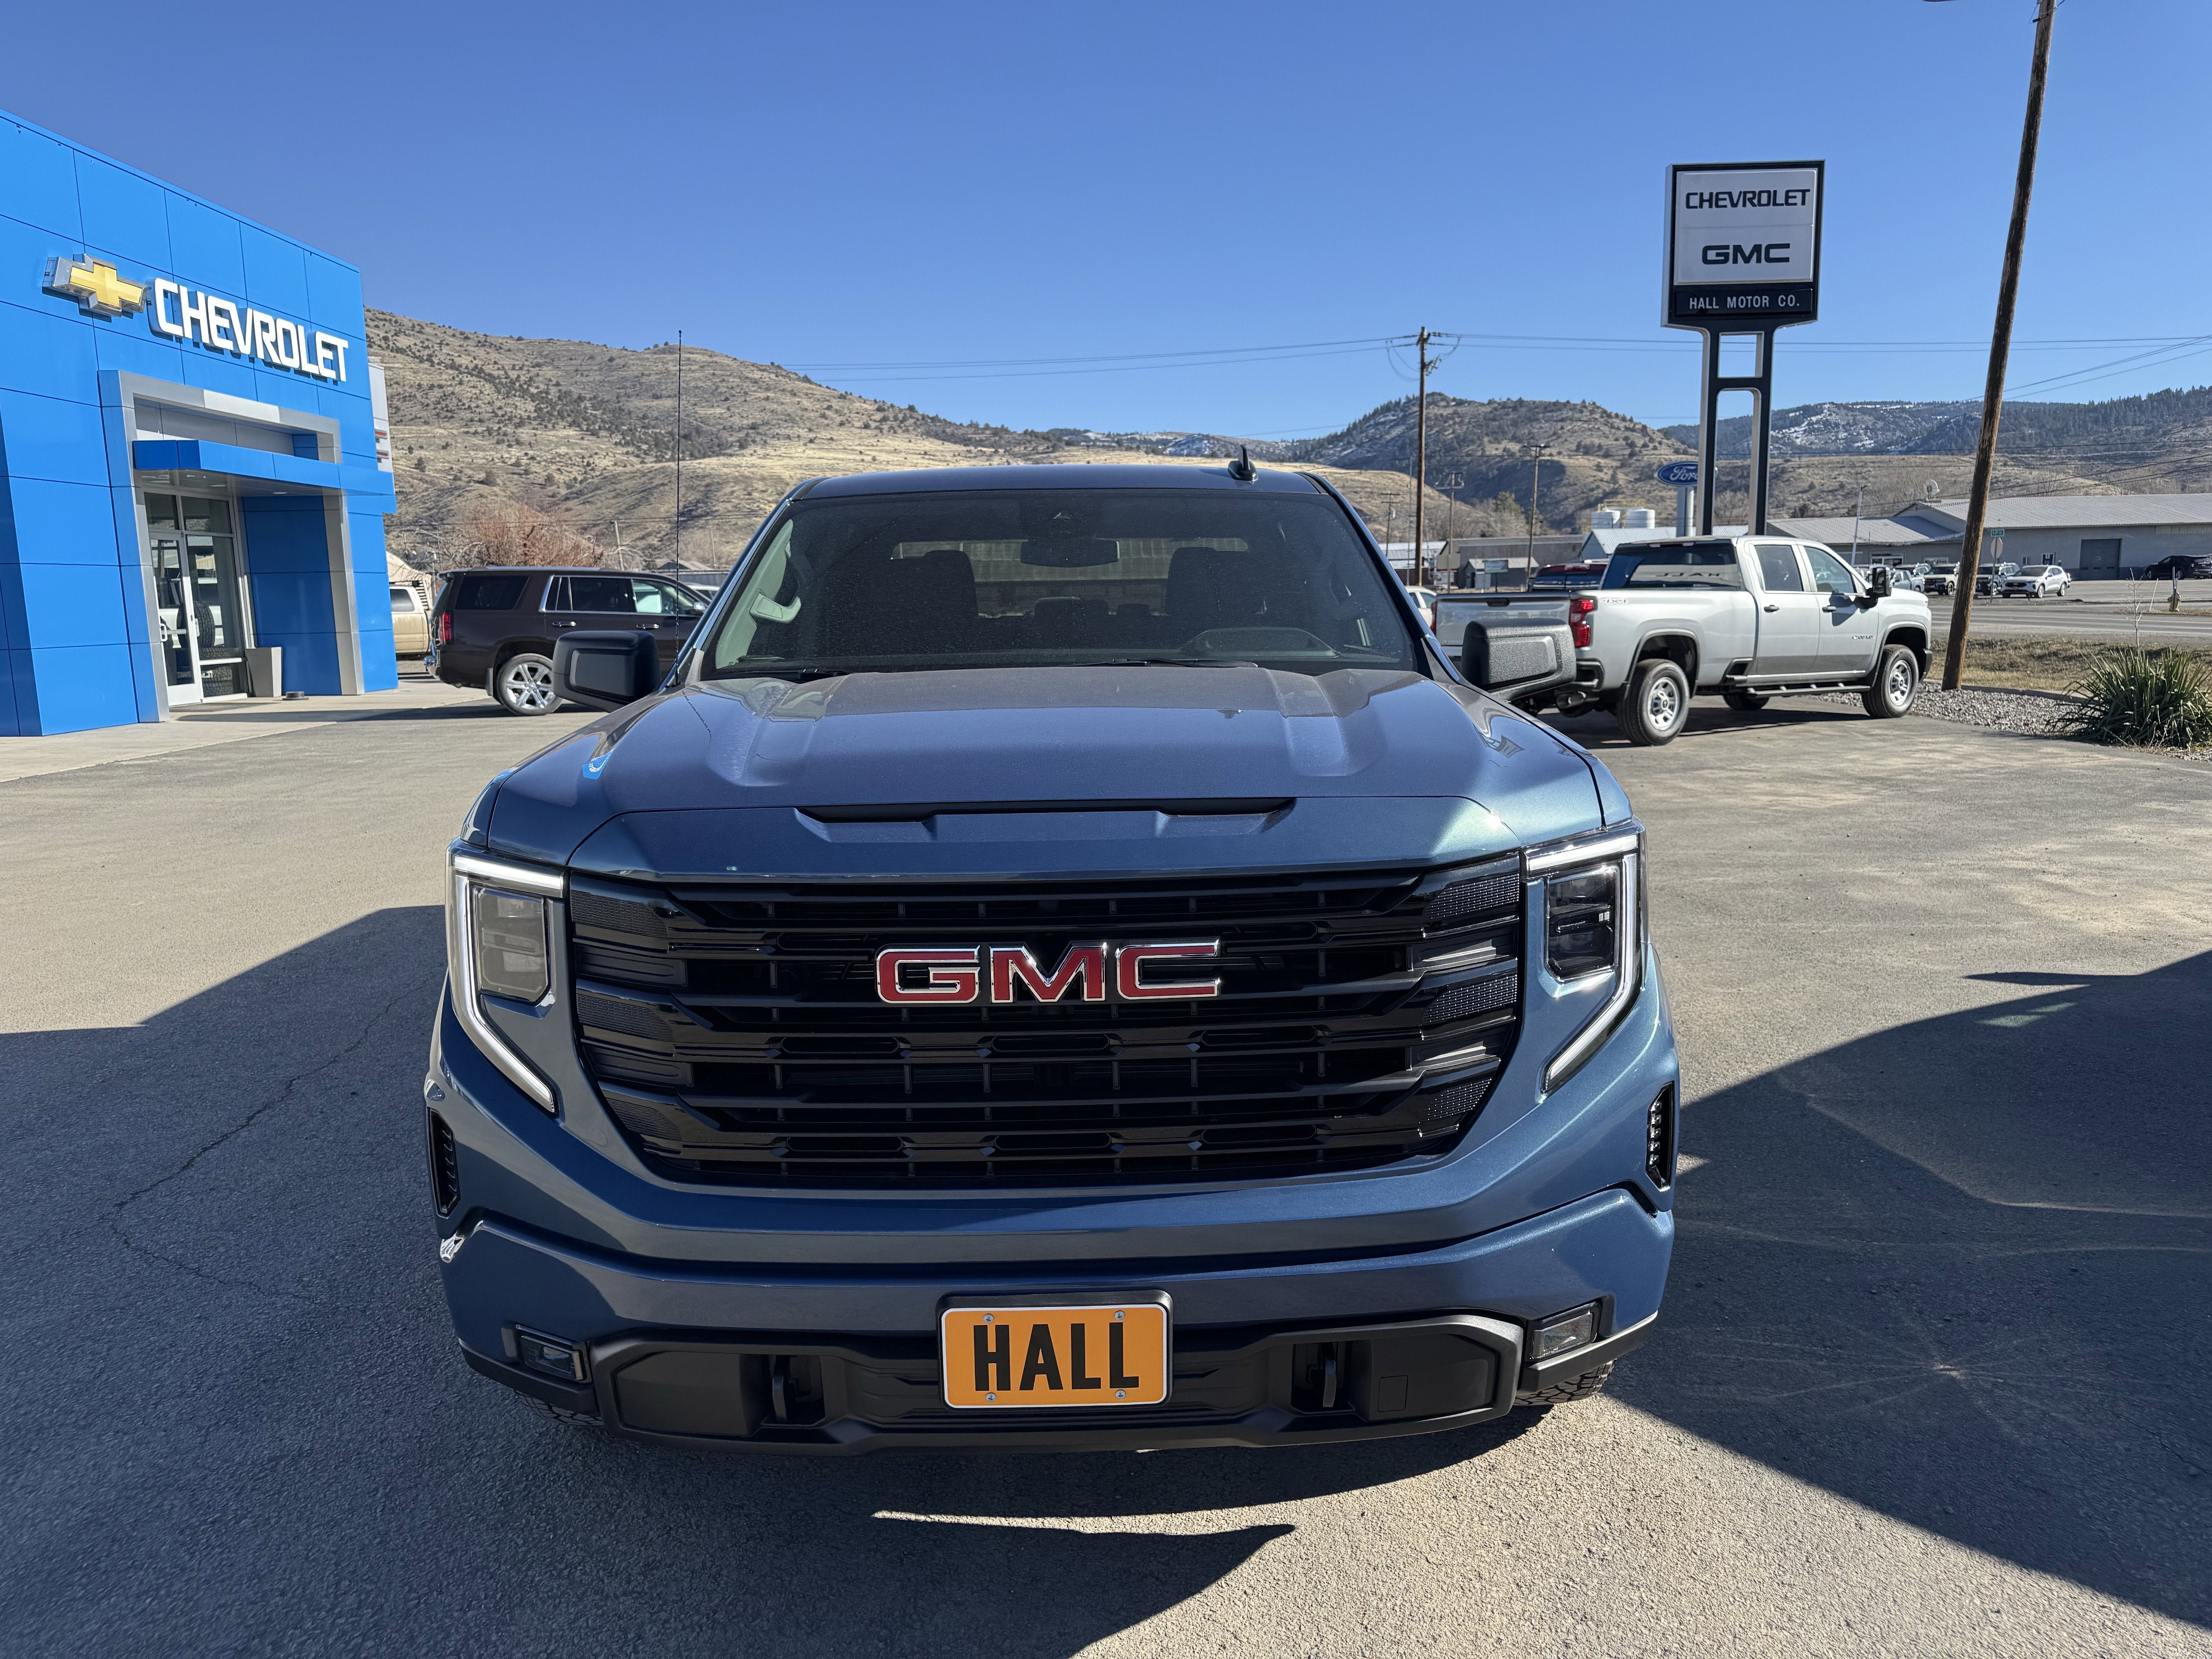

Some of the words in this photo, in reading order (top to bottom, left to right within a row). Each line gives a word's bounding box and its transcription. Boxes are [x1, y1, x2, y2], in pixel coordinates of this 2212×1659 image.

[1685, 189, 1811, 209] CHEVROLET
[1702, 243, 1791, 265] GMC
[1689, 296, 1719, 309] HALL
[1726, 295, 1769, 309] MOTOR
[1778, 294, 1800, 307] CO.
[153, 277, 349, 382] CHEVROLET
[876, 939, 1221, 1004] GMC
[973, 1322, 1140, 1391] HALL
